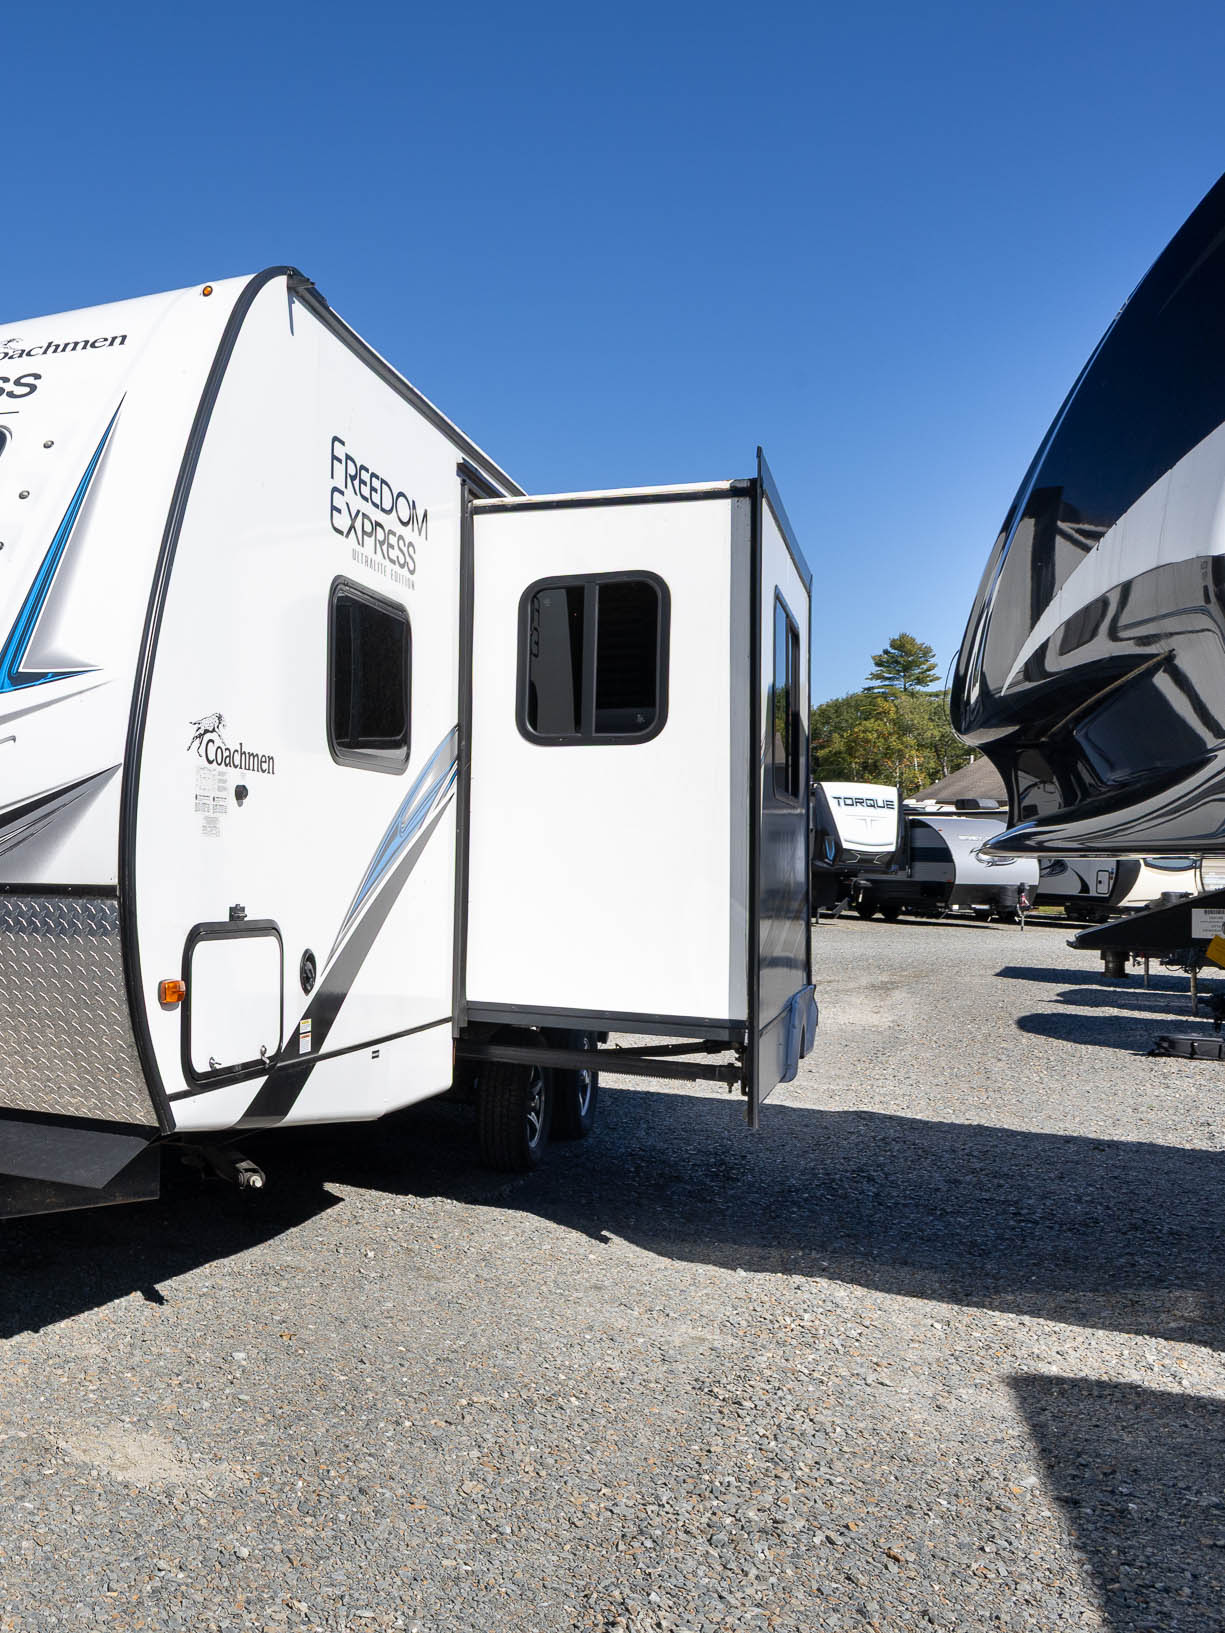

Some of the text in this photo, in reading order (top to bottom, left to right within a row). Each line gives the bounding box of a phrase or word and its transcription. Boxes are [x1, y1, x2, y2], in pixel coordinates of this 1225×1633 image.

[330, 435, 428, 541] FREEDOM
[330, 486, 416, 575] EXPRESS
[205, 738, 275, 775] Coachmen
[832, 796, 895, 810] TORQUE
